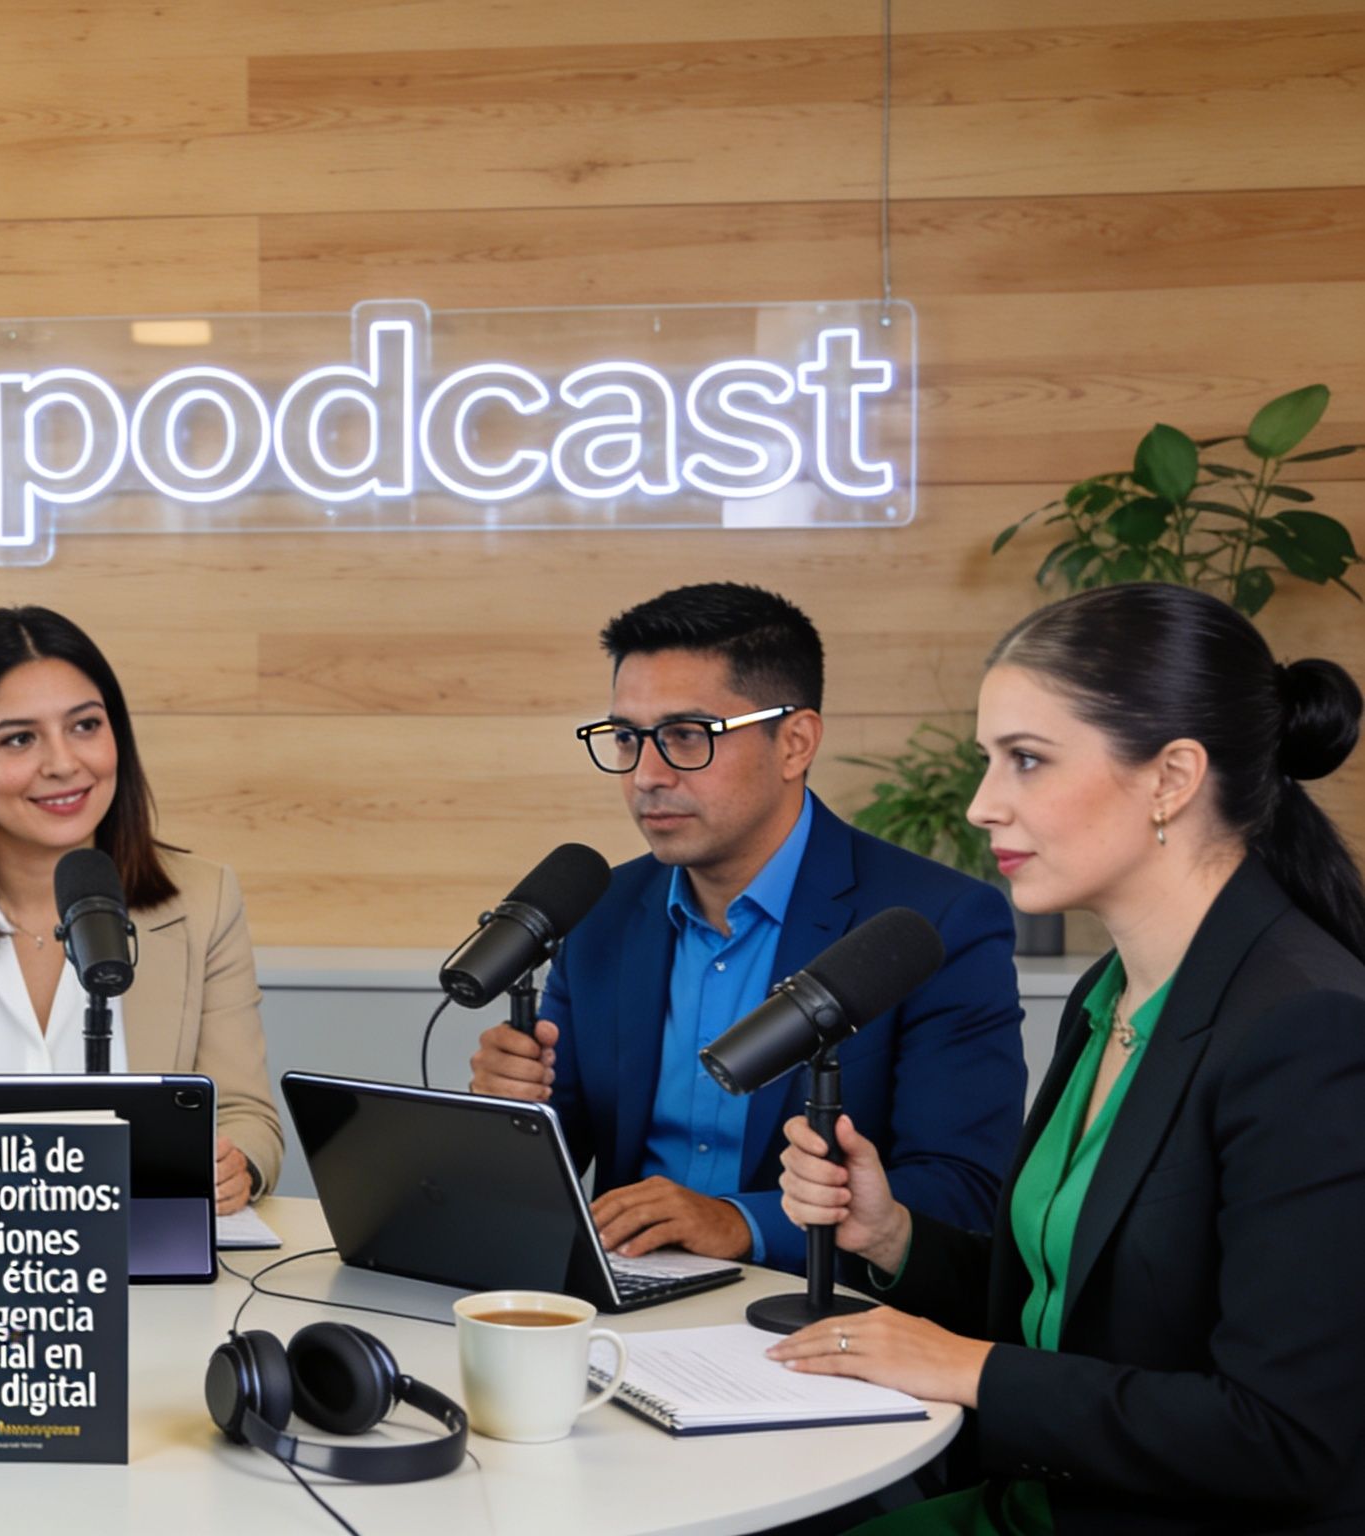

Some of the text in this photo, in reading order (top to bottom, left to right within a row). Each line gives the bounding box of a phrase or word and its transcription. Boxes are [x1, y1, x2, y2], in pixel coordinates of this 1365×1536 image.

[45, 1136, 85, 1173] de
[2, 1259, 79, 1294] ética
[86, 1267, 108, 1294] e
[44, 1343, 83, 1370] en
[0, 1371, 97, 1417] digital
